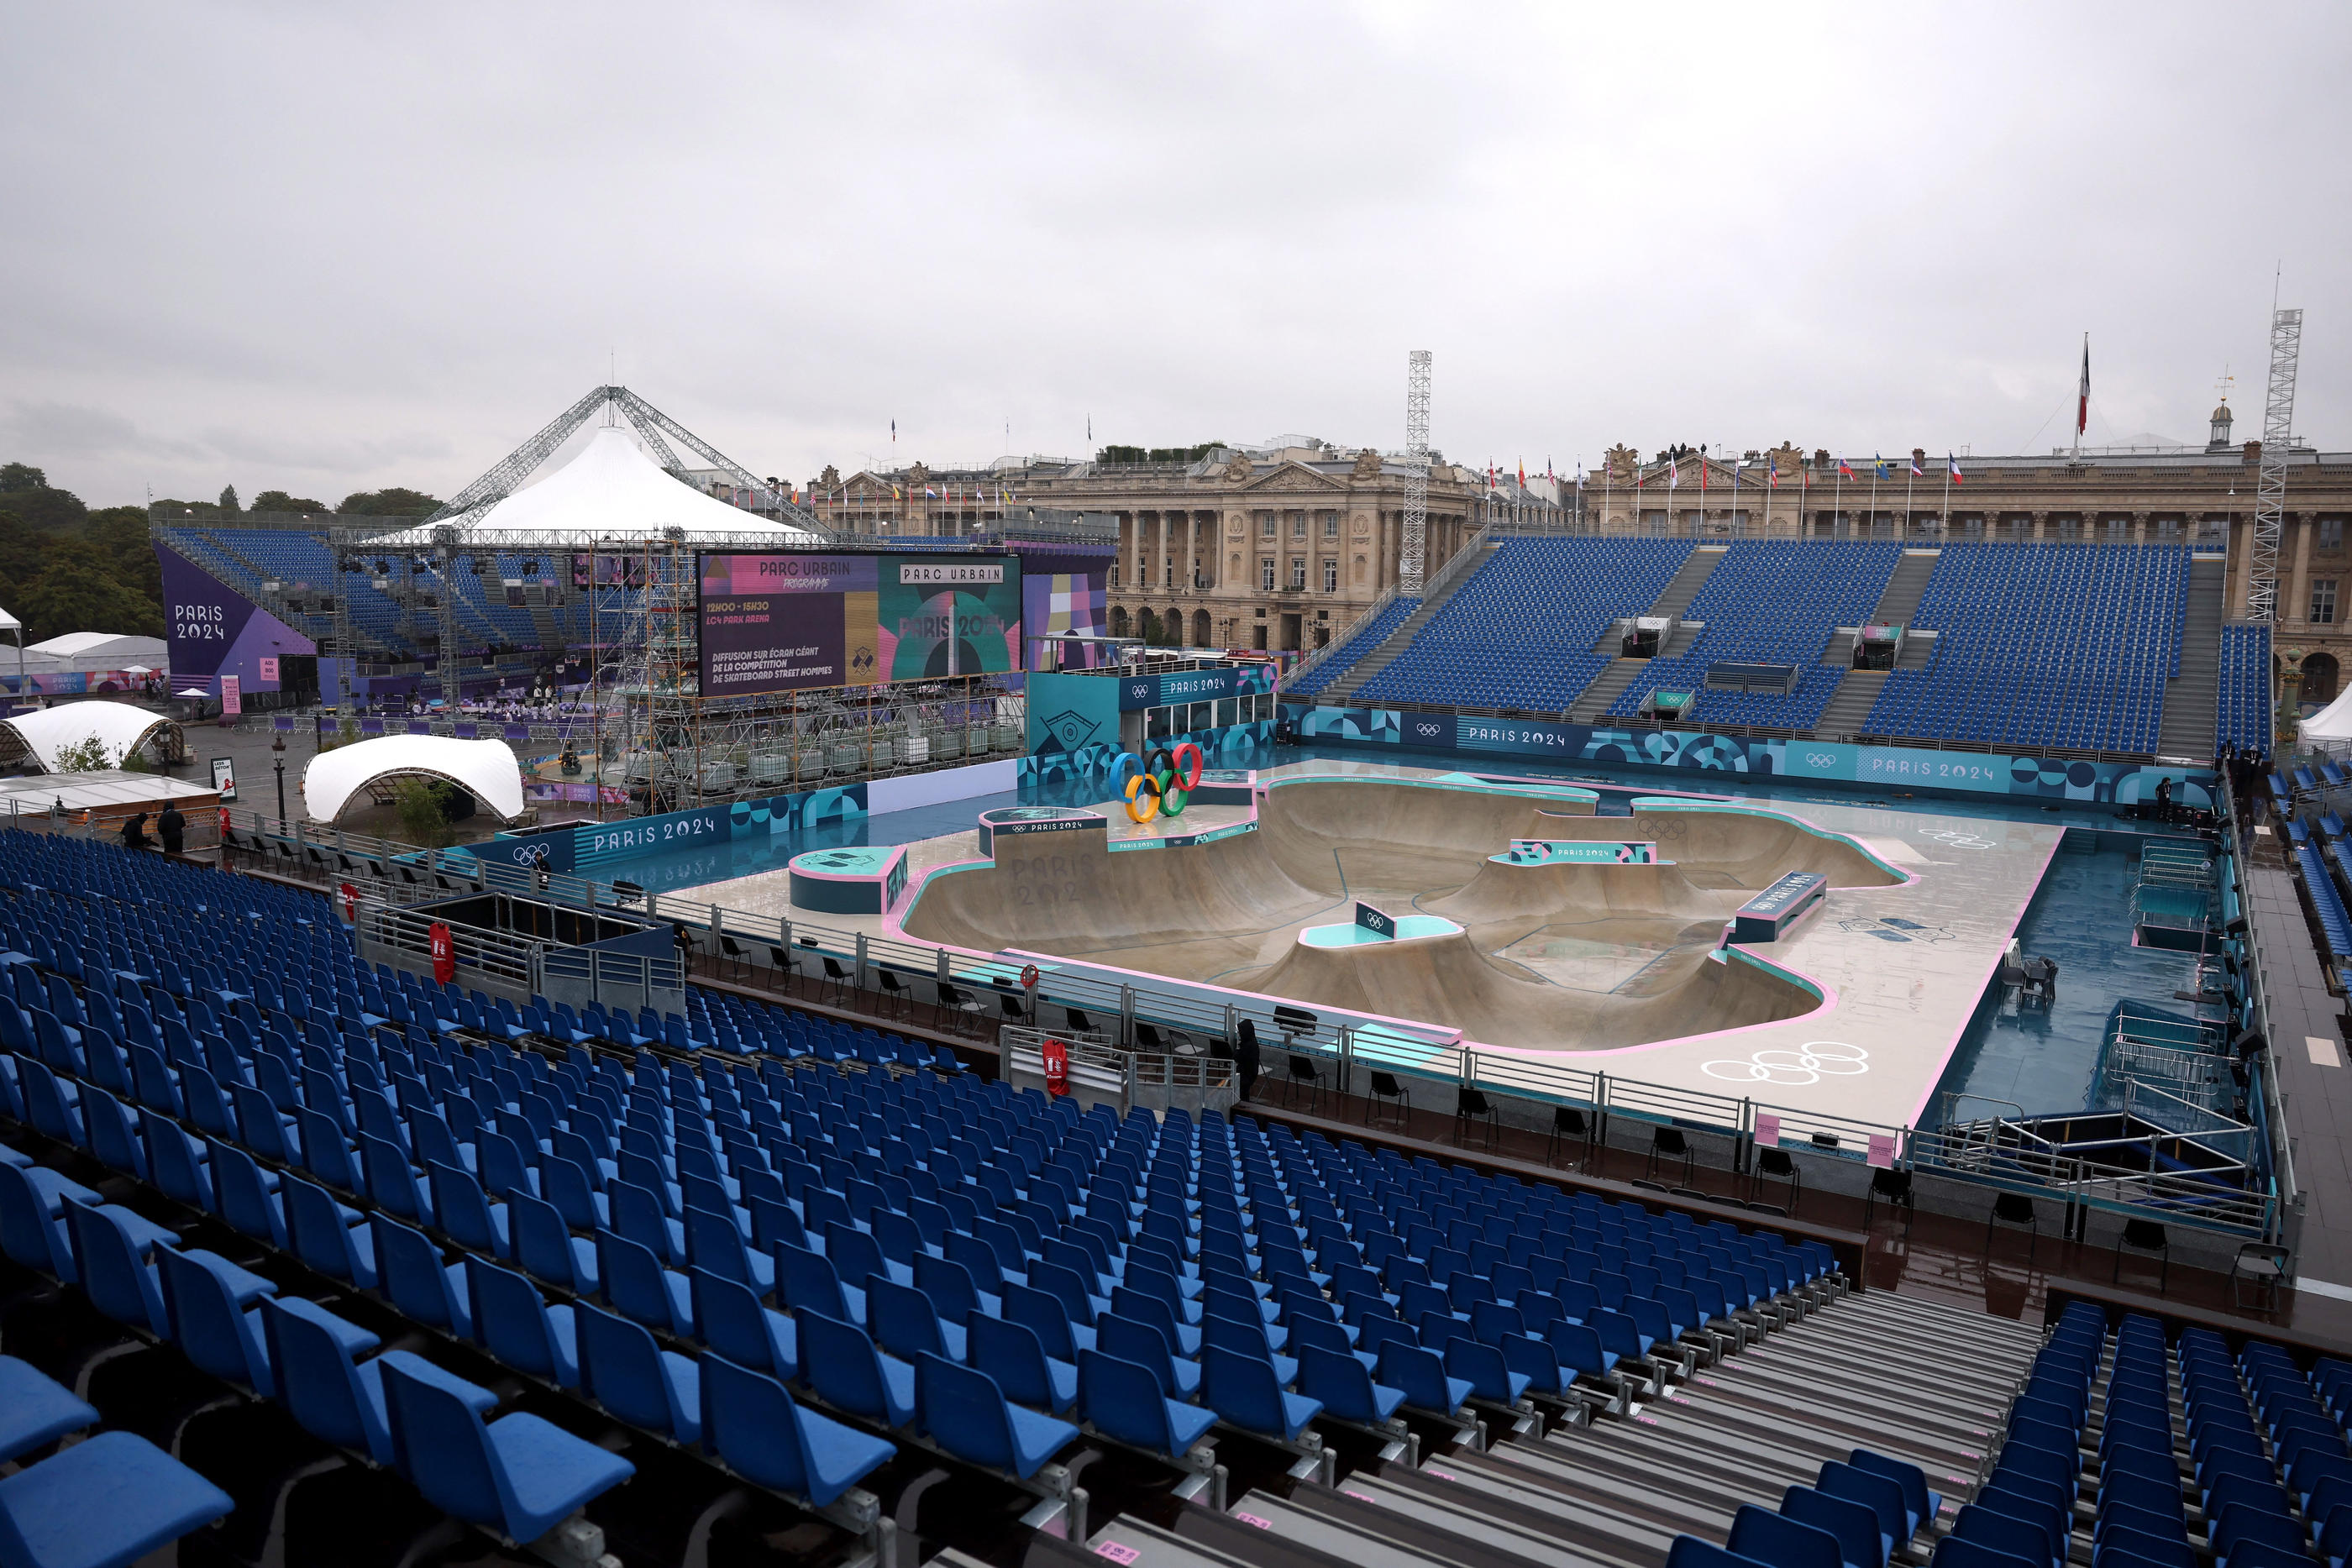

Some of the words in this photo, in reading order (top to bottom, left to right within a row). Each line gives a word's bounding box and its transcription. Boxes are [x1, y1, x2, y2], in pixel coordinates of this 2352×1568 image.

[760, 562, 798, 576] PARC
[803, 561, 850, 575] URBAIN
[904, 569, 942, 579] PARC
[951, 569, 1000, 579] URBAIN
[783, 578, 830, 590] PROGRAMME
[722, 615, 743, 624] PARK
[745, 614, 769, 623] ARENA
[176, 623, 224, 639] 2024
[712, 651, 753, 662] DIFFUSION
[753, 650, 768, 659] SUR
[769, 648, 794, 658] ÉCRAN
[795, 646, 819, 657] GÉANT
[712, 663, 722, 673] DE
[723, 663, 733, 672] LA
[734, 658, 788, 670] COMPÉTITION
[712, 674, 723, 684] DE
[724, 671, 774, 682] SKATEBOARD
[774, 669, 800, 679] STREET
[801, 666, 832, 676] HOMMES
[1201, 678, 1225, 690] 2024
[1522, 732, 1565, 746] 2024
[1939, 763, 1994, 780] 2024
[664, 817, 714, 840] 2024
[1059, 821, 1082, 830] 2024
